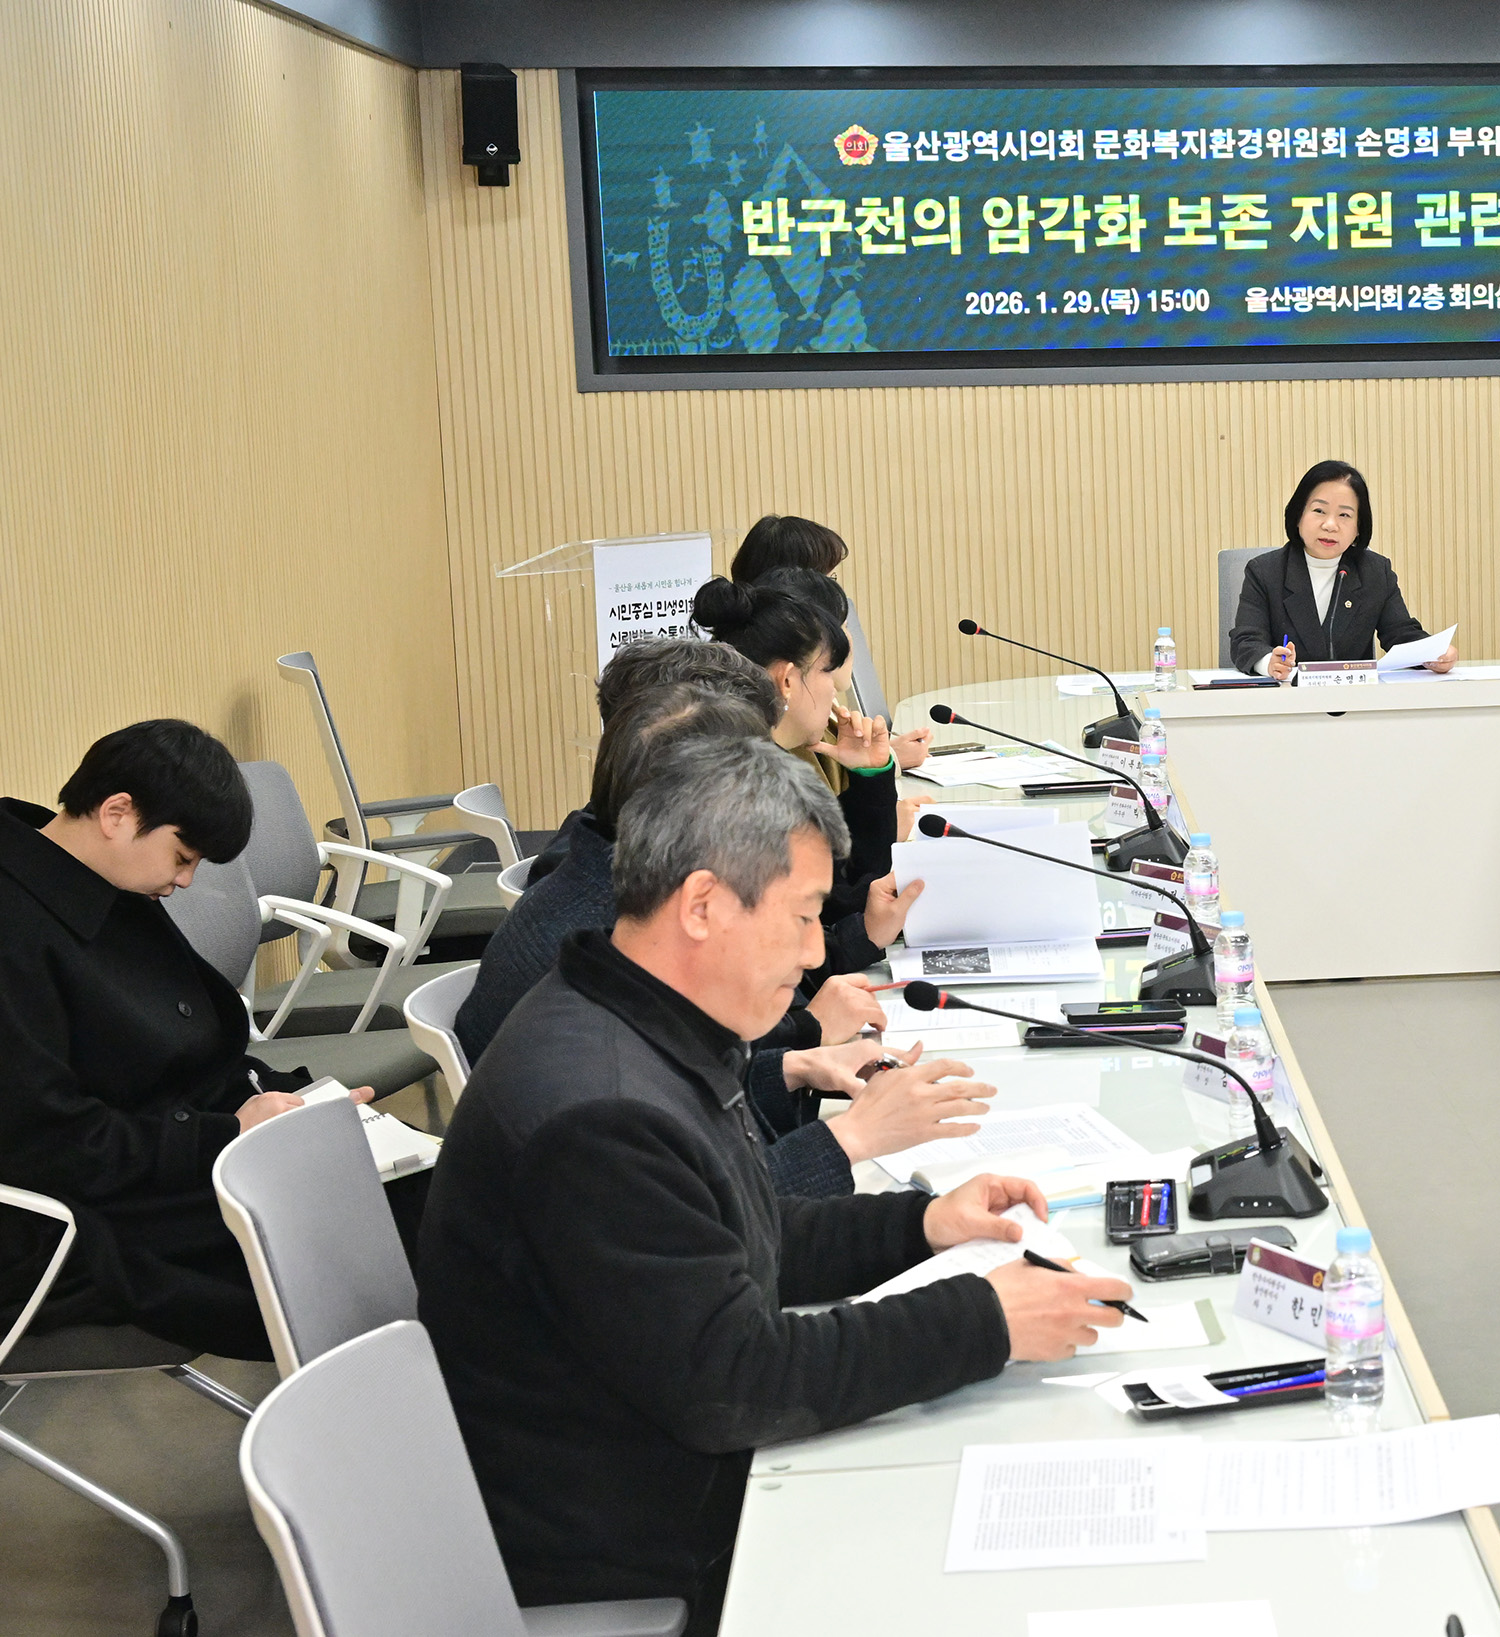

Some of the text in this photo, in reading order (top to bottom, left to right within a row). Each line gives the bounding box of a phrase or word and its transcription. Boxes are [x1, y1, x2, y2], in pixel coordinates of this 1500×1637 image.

[882, 129, 1085, 163] 울산광역시의회
[1092, 126, 1347, 161] 문화복지환경위원회
[1354, 126, 1439, 158] 손명희
[742, 195, 962, 257] 반구천의
[982, 193, 1147, 255] 암각화
[1163, 193, 1272, 251] 보존
[1289, 191, 1393, 251] 지원
[965, 287, 1210, 316] 2026. 1. 29.(목) 15:00
[1244, 284, 1403, 313] 울산광역시의회
[1407, 284, 1446, 312] 2층
[609, 601, 653, 621] 시민중심
